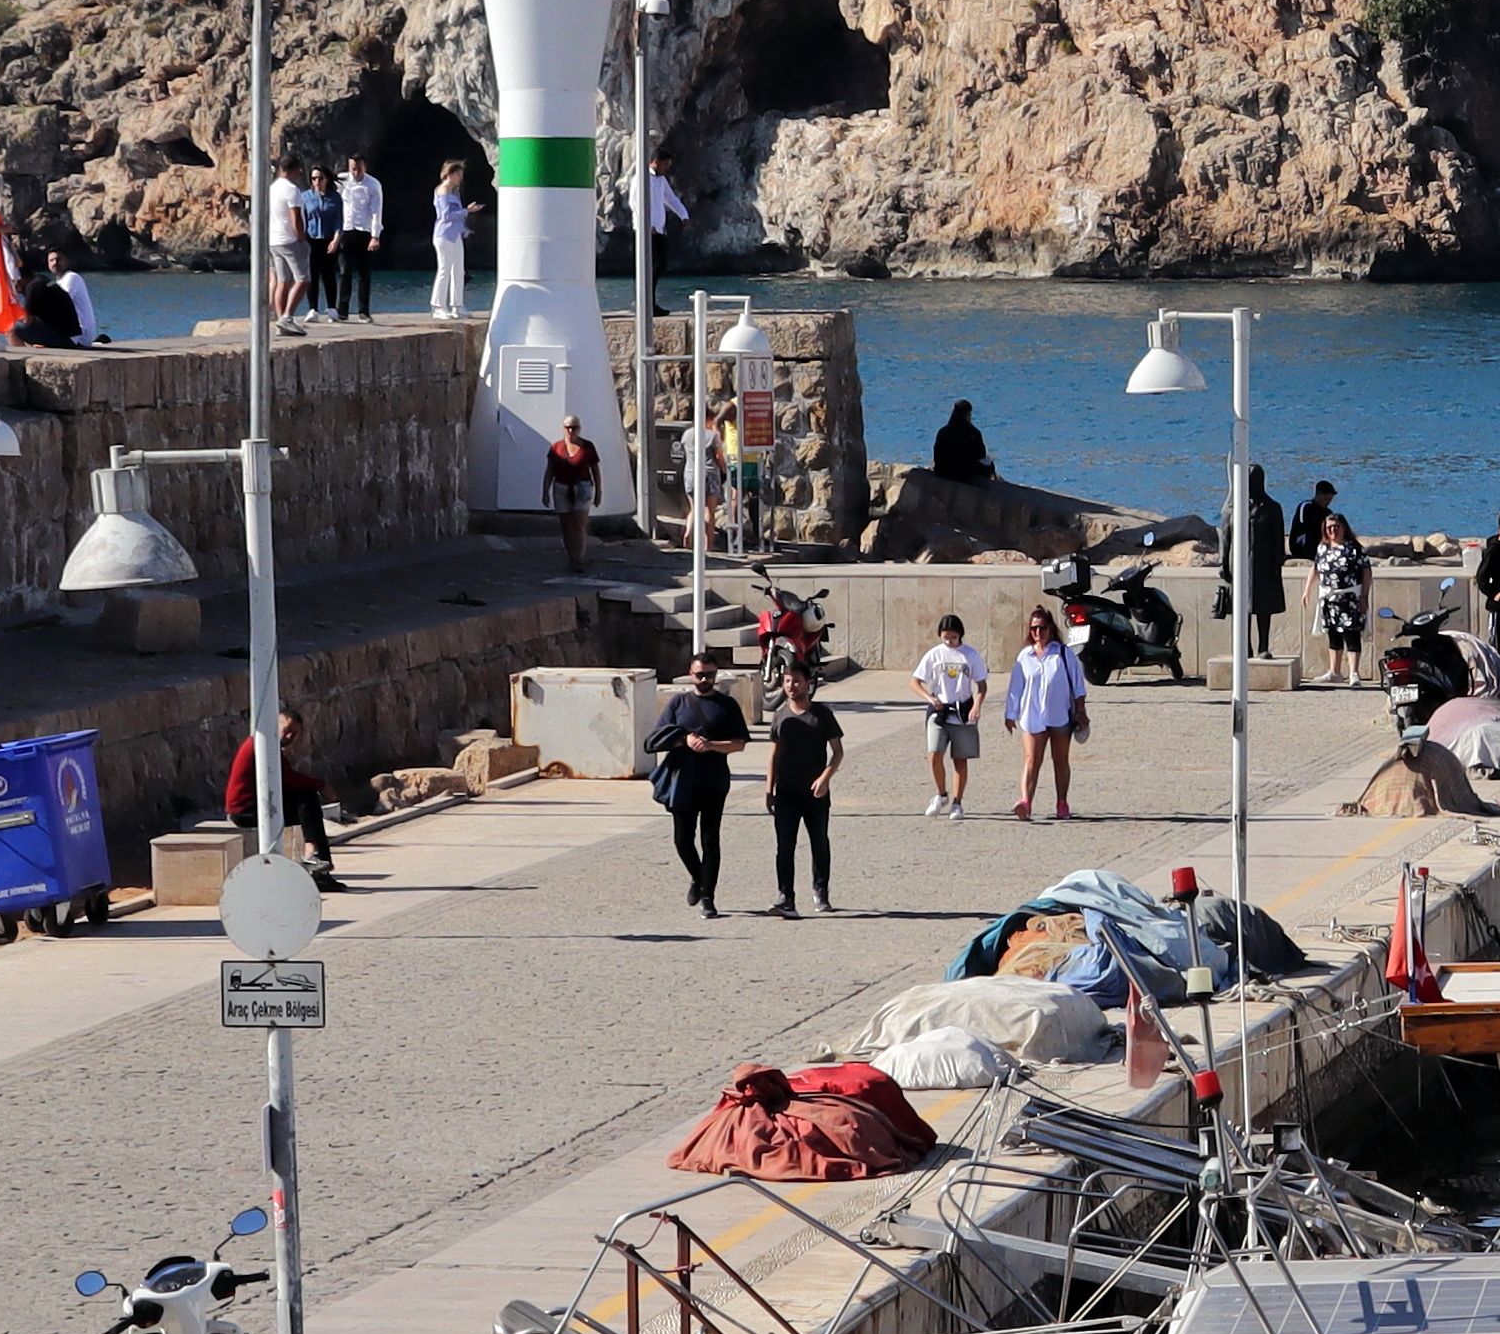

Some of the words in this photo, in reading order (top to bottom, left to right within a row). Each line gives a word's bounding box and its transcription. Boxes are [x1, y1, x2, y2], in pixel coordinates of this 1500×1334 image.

[227, 1000, 249, 1022] Araç
[251, 1000, 283, 1022] Çekme
[285, 1000, 320, 1022] Bölgesi
